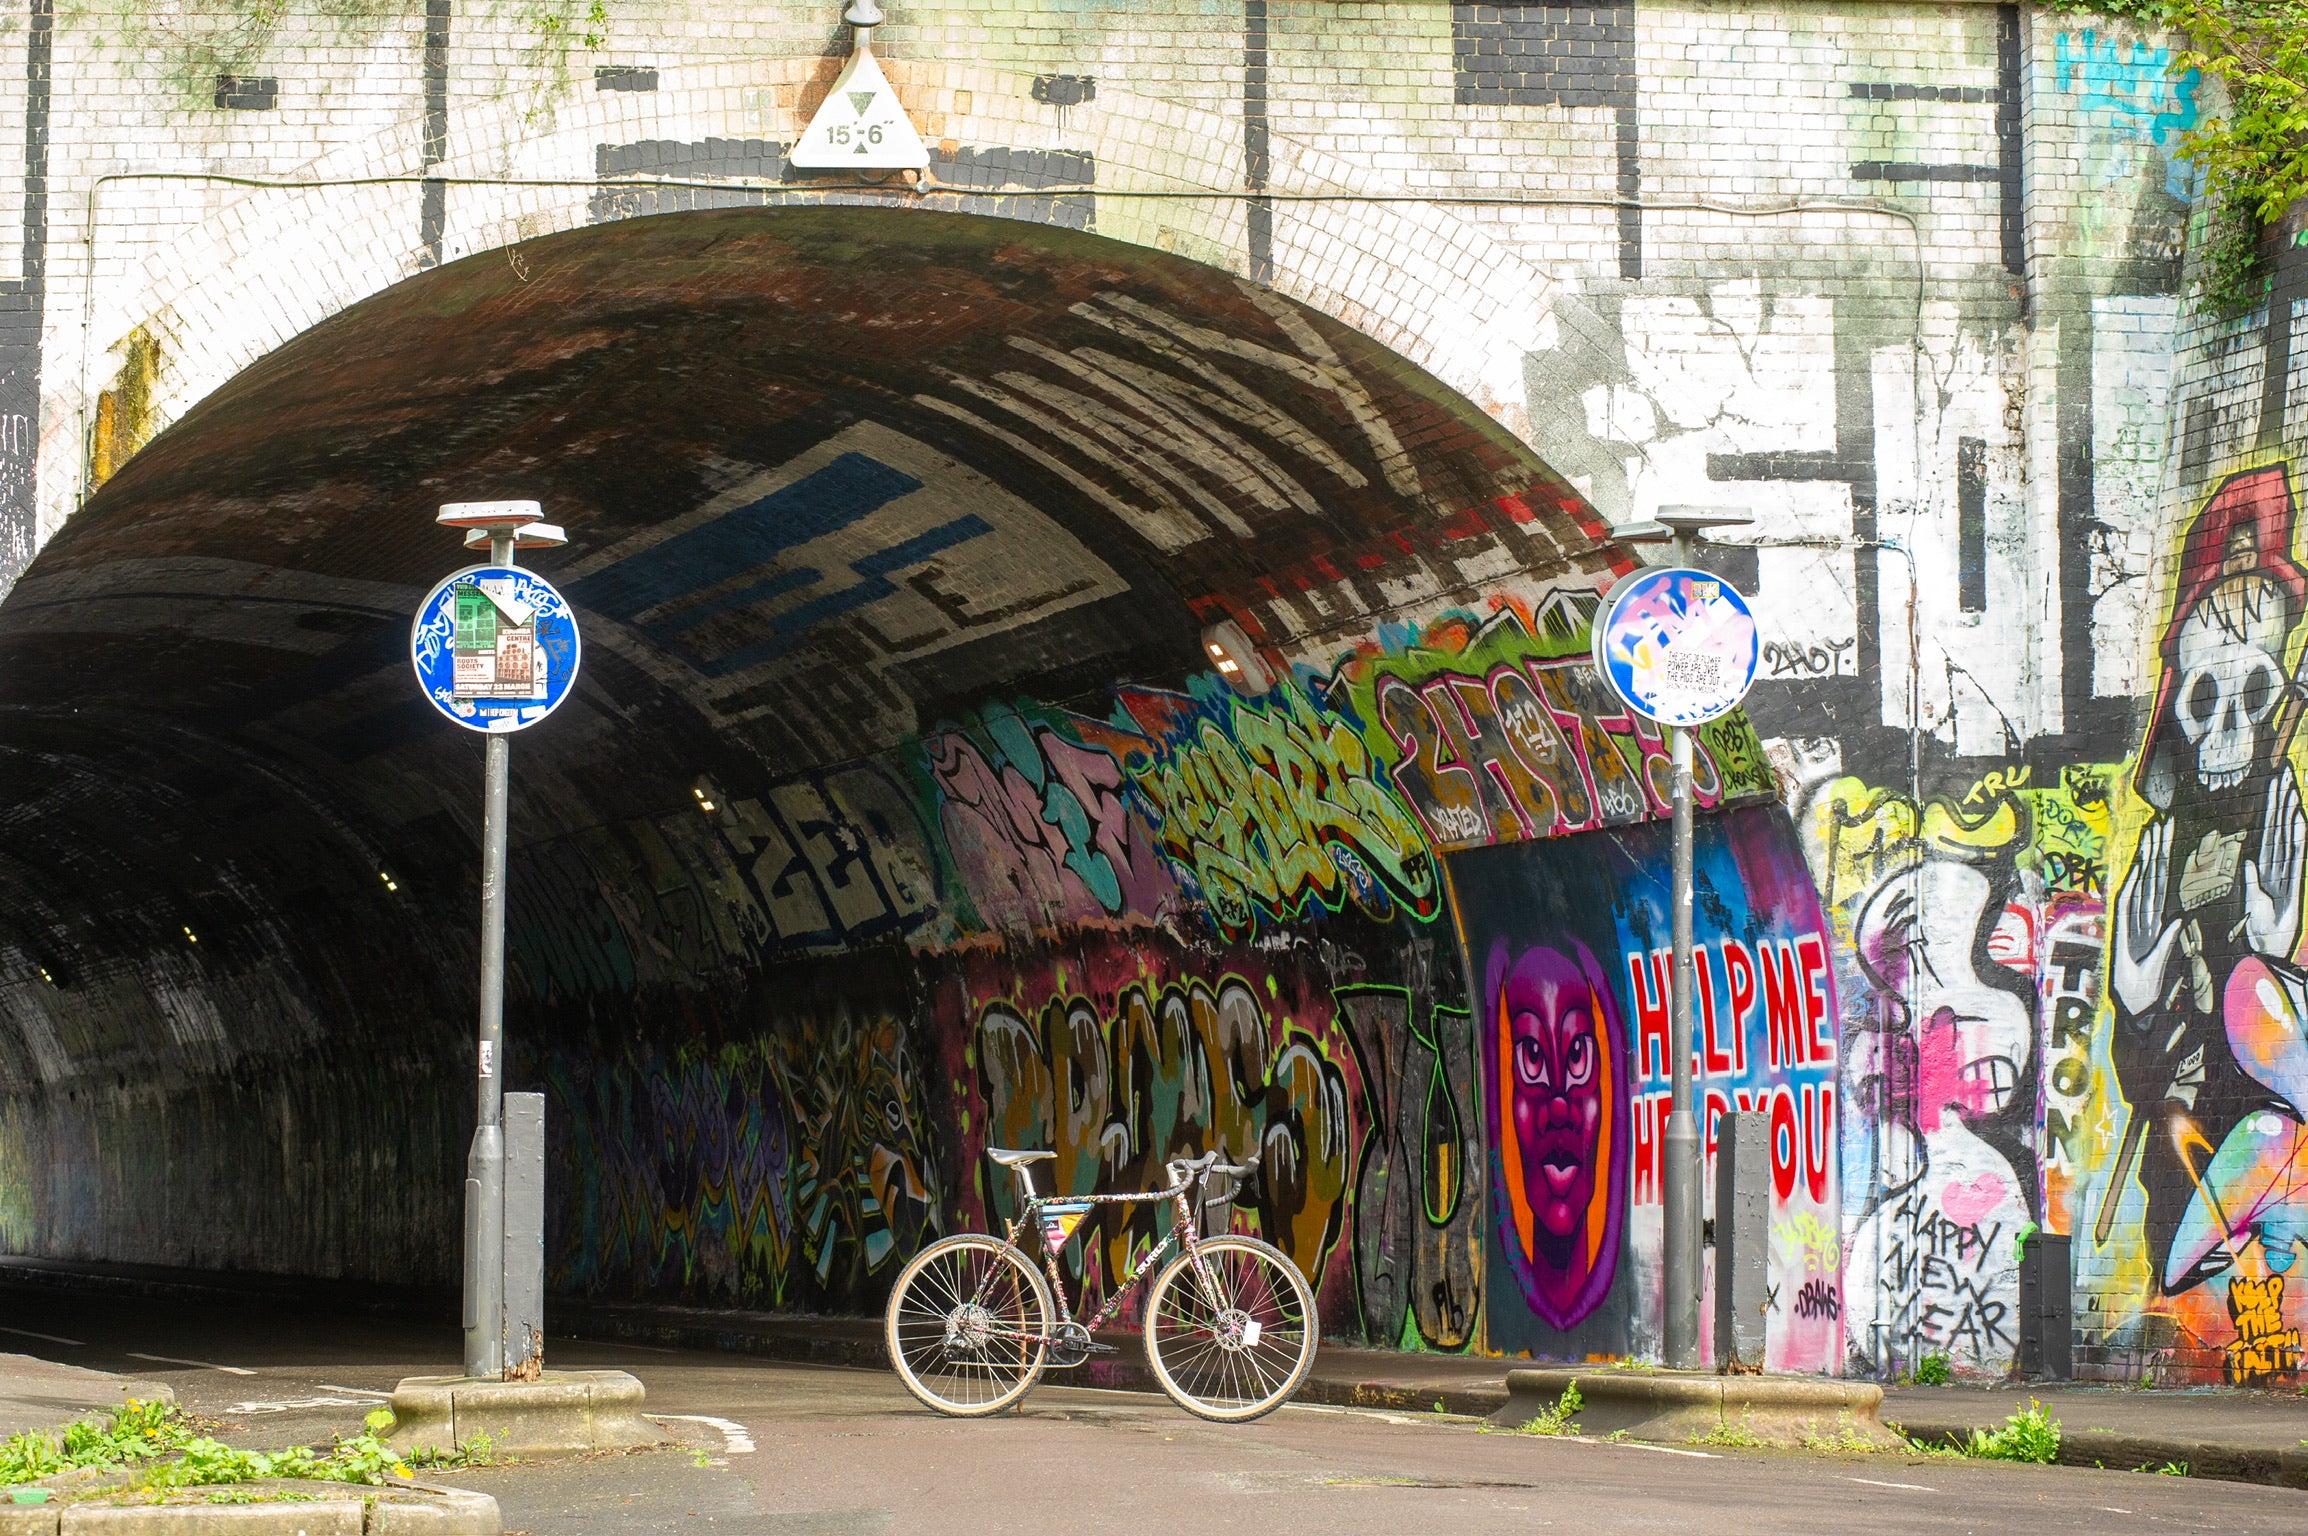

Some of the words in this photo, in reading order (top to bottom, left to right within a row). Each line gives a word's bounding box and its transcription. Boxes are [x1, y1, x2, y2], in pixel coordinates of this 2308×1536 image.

[455, 683, 493, 691] SATURDAY
[1667, 670, 1678, 682] THE
[1757, 932, 1838, 1073] ME
[1894, 1194, 2001, 1273] HAPPY
[1884, 1241, 1993, 1305] NEW
[1880, 1278, 2019, 1358] YEAR
